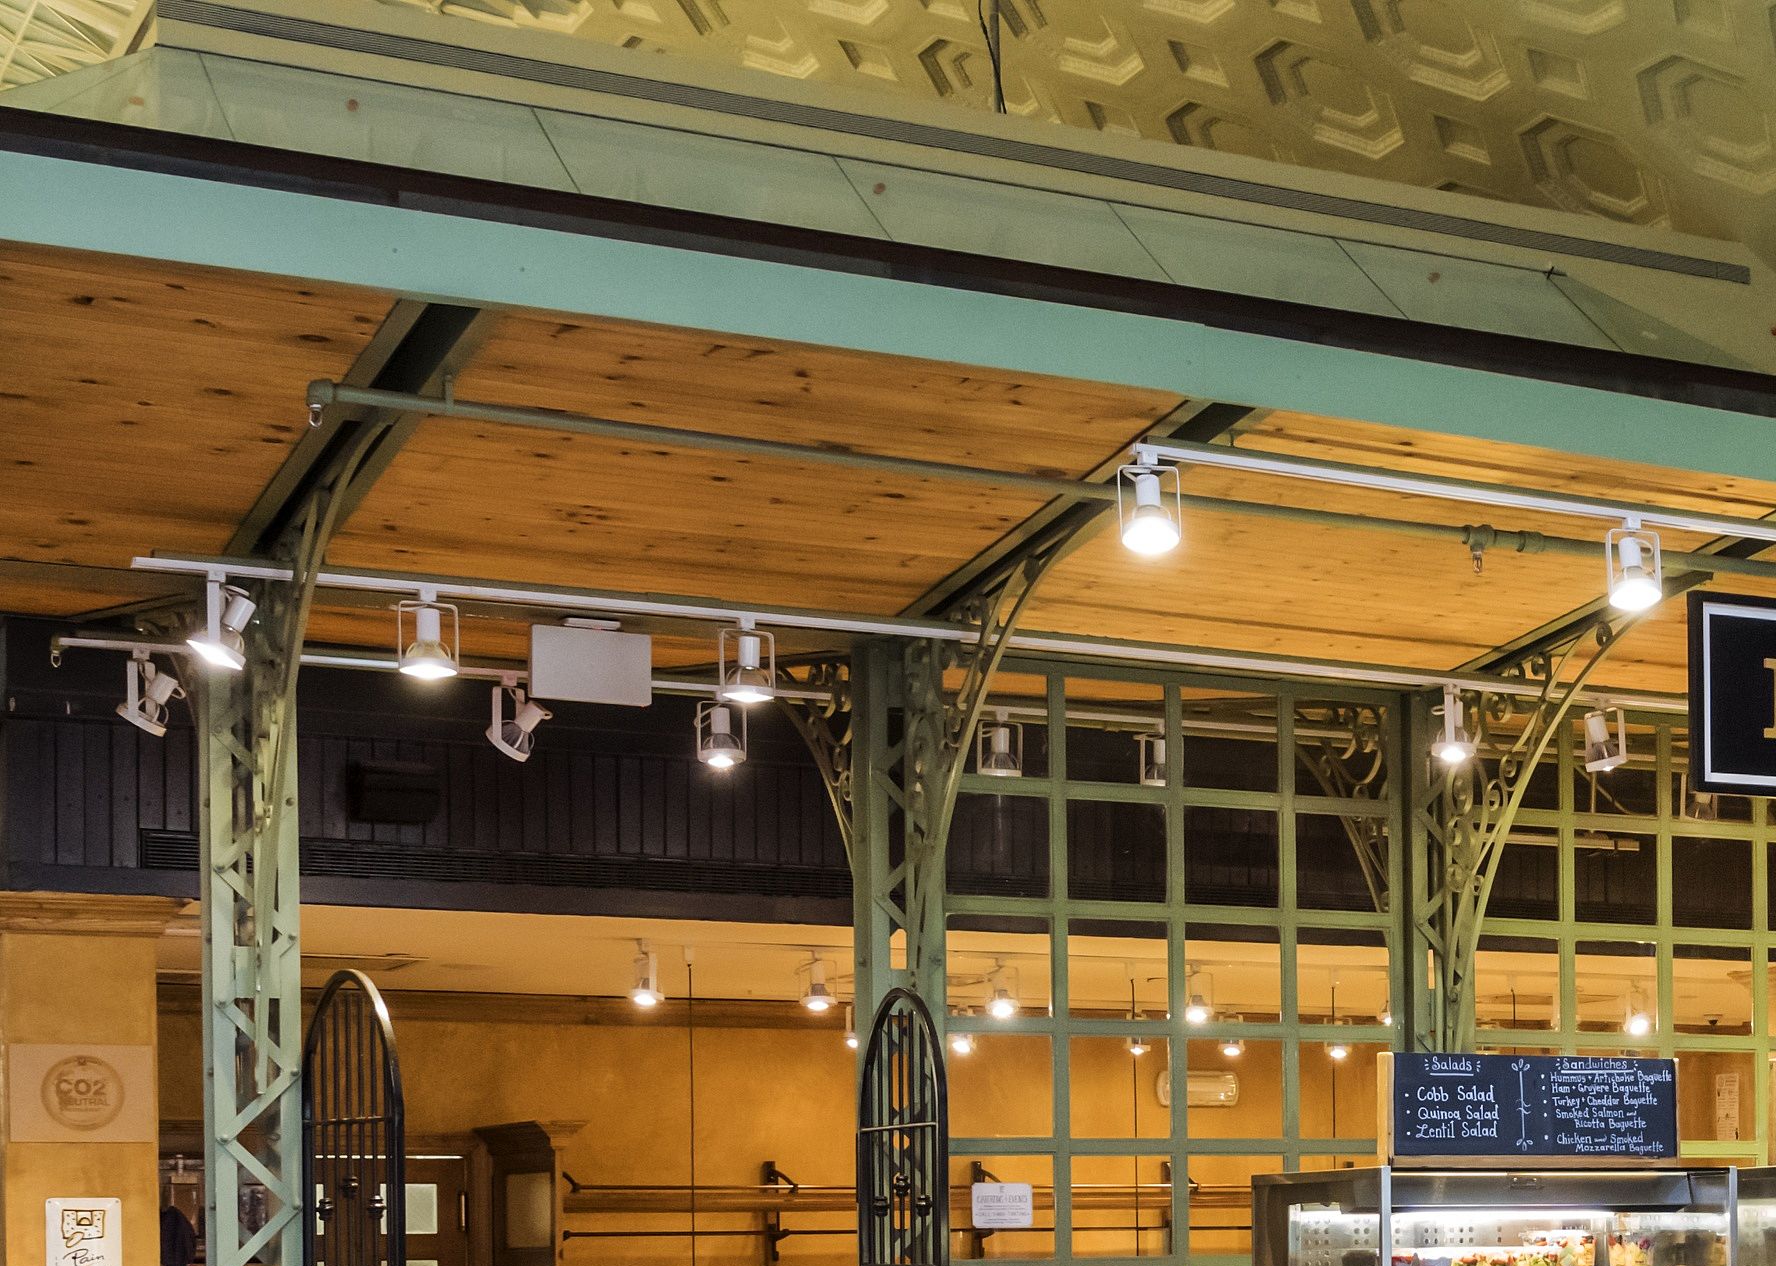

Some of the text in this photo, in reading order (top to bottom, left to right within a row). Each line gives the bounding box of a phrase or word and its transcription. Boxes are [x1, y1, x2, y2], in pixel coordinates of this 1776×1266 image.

[1431, 1056, 1473, 1071] Salads
[1562, 1058, 1628, 1070] Sandwiches
[1550, 1072, 1586, 1083] Hummus
[1593, 1073, 1635, 1083] Artichoke
[1637, 1070, 1672, 1085] Baguette
[55, 1078, 107, 1096] CO2
[1417, 1084, 1496, 1103] Cobb Salad
[1551, 1083, 1571, 1093] Ham
[1612, 1082, 1651, 1096] Baguette
[1551, 1093, 1658, 1109] Turkey Cheddar Baguette
[1417, 1103, 1500, 1120] Quinoa Salad
[1555, 1107, 1590, 1119] Smoked
[1591, 1107, 1624, 1118] Salmon
[1415, 1120, 1498, 1139] Lentil Salad
[1574, 1117, 1648, 1131] Ricotta Baguette
[1556, 1132, 1592, 1145] Chicken
[1609, 1131, 1644, 1144] Smoked
[1575, 1141, 1665, 1155] Mozzarella Baguette
